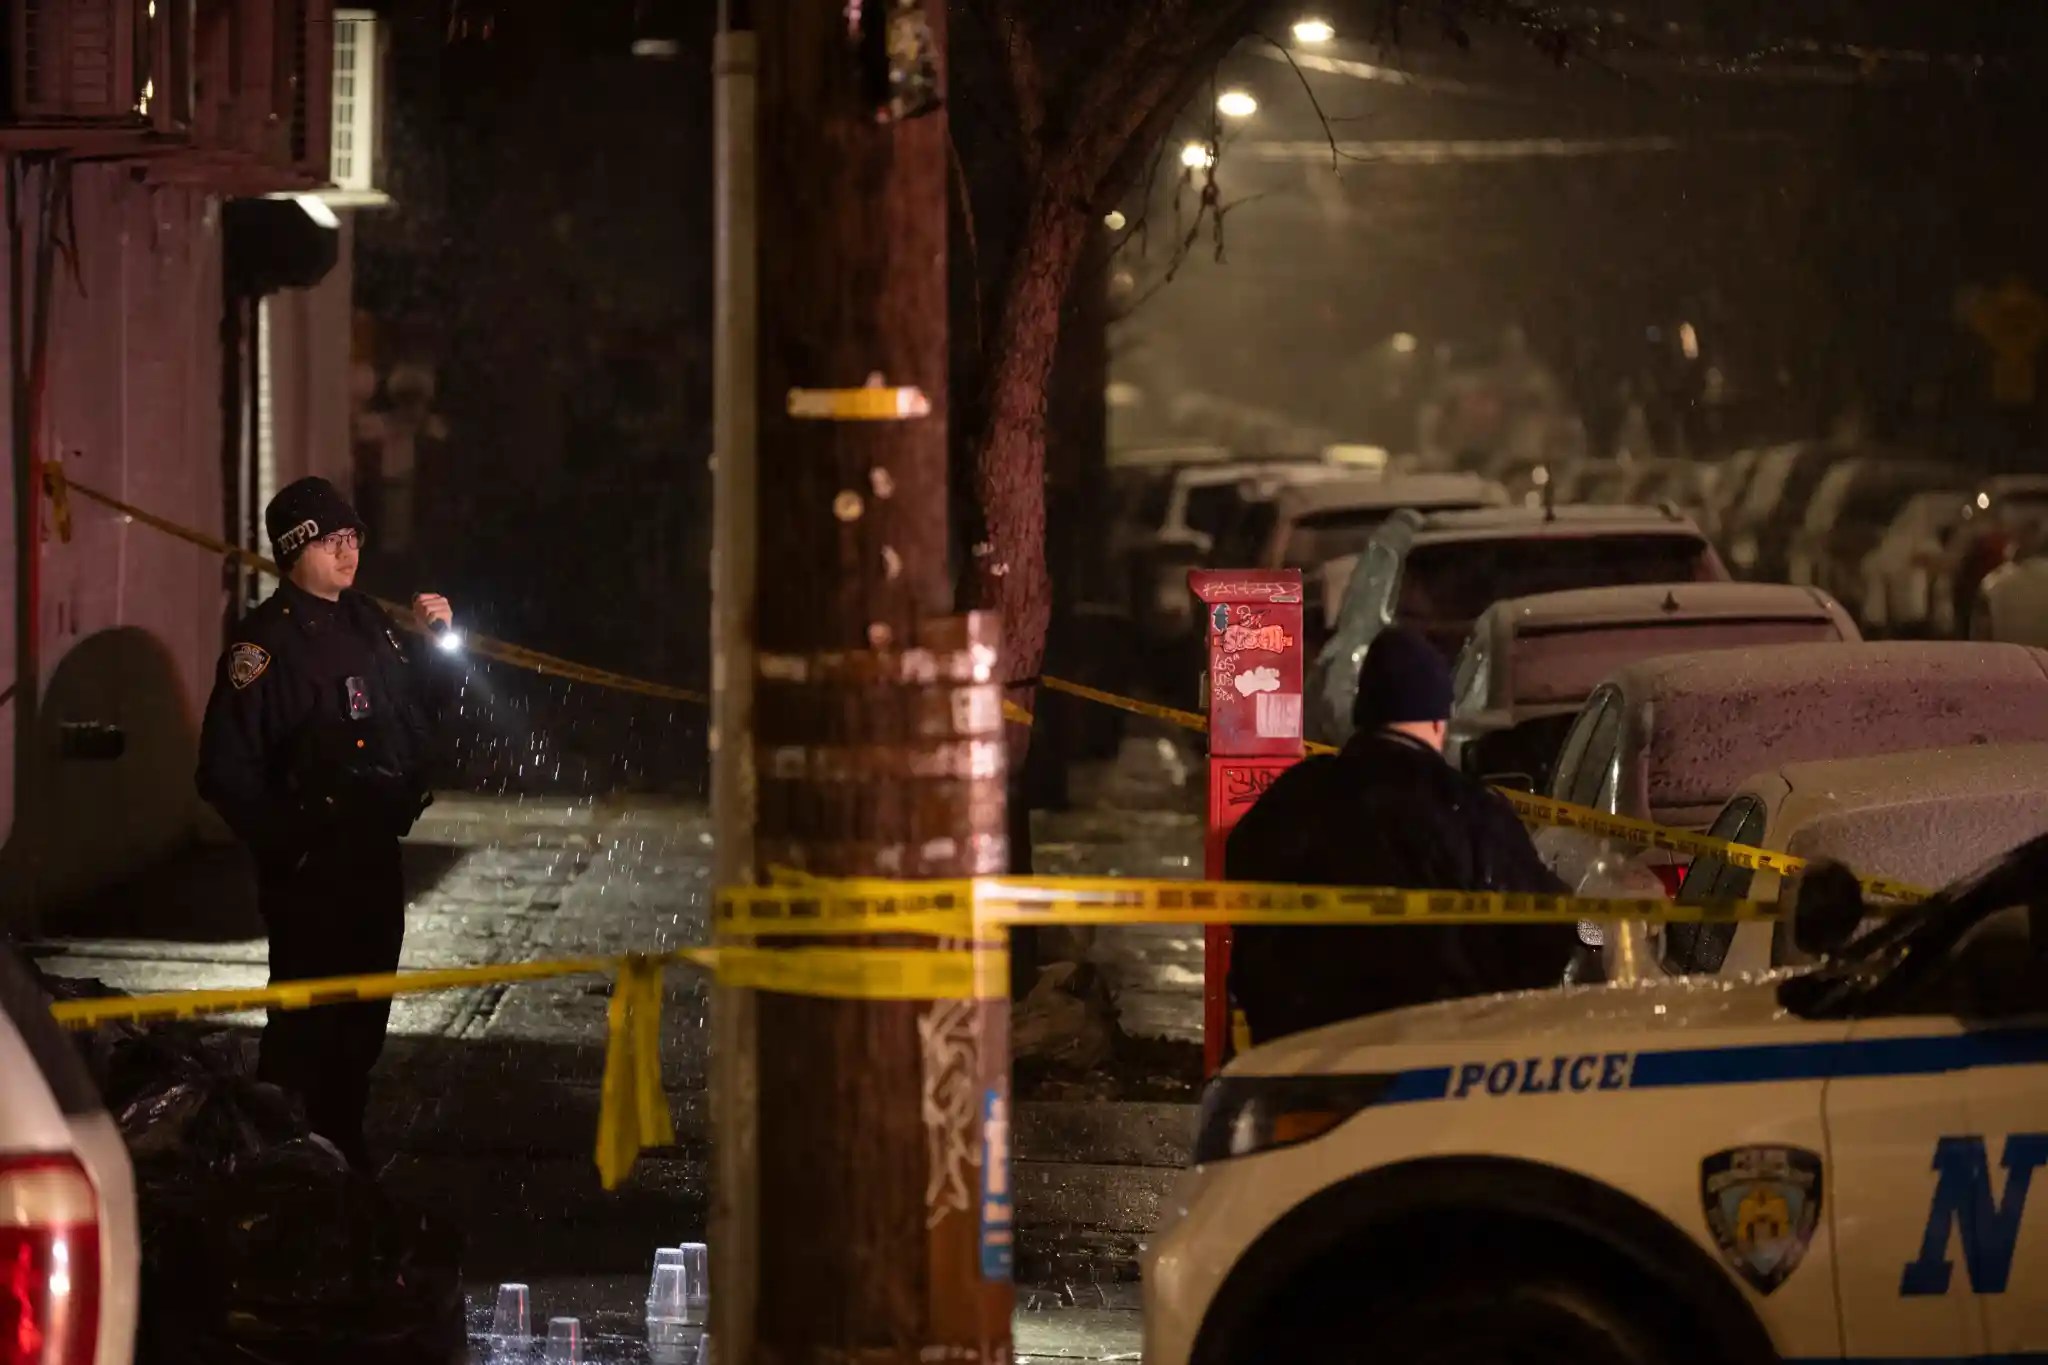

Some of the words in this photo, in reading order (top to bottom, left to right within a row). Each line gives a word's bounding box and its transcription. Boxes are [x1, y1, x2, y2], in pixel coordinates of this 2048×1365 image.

[278, 519, 319, 555] NYPD
[1453, 1052, 1630, 1099] POLICE
[1898, 1134, 2048, 1296] N
